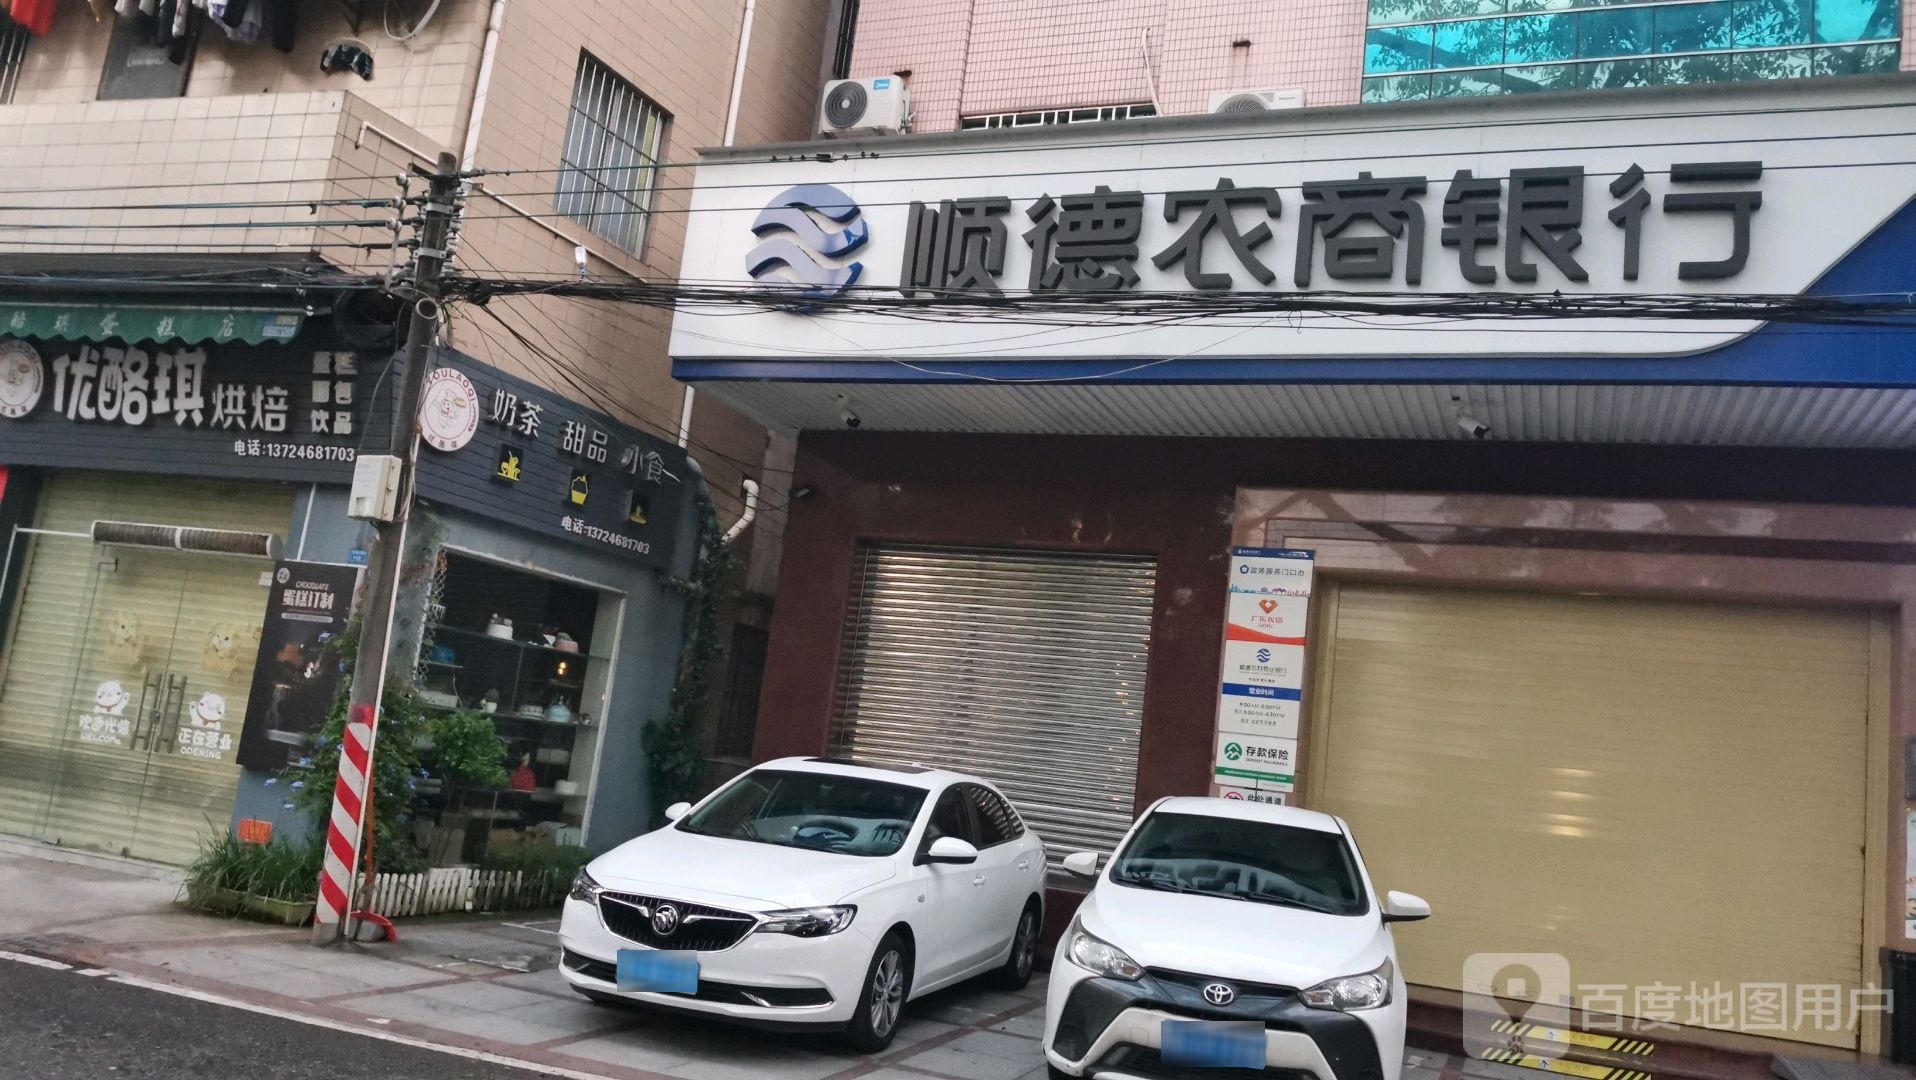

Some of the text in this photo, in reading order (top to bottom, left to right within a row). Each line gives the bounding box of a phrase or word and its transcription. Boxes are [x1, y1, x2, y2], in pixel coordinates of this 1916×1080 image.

[900, 162, 1763, 298] 顺德农商银行
[52, 345, 289, 432] 优酪琪 烘焙
[310, 409, 352, 434] 饮品
[492, 388, 544, 438] 奶茶
[563, 420, 609, 464] 甜品
[233, 439, 355, 463] 电话:13724681703
[178, 727, 233, 751] 正在营业
[1246, 745, 1289, 761] 存款保险
